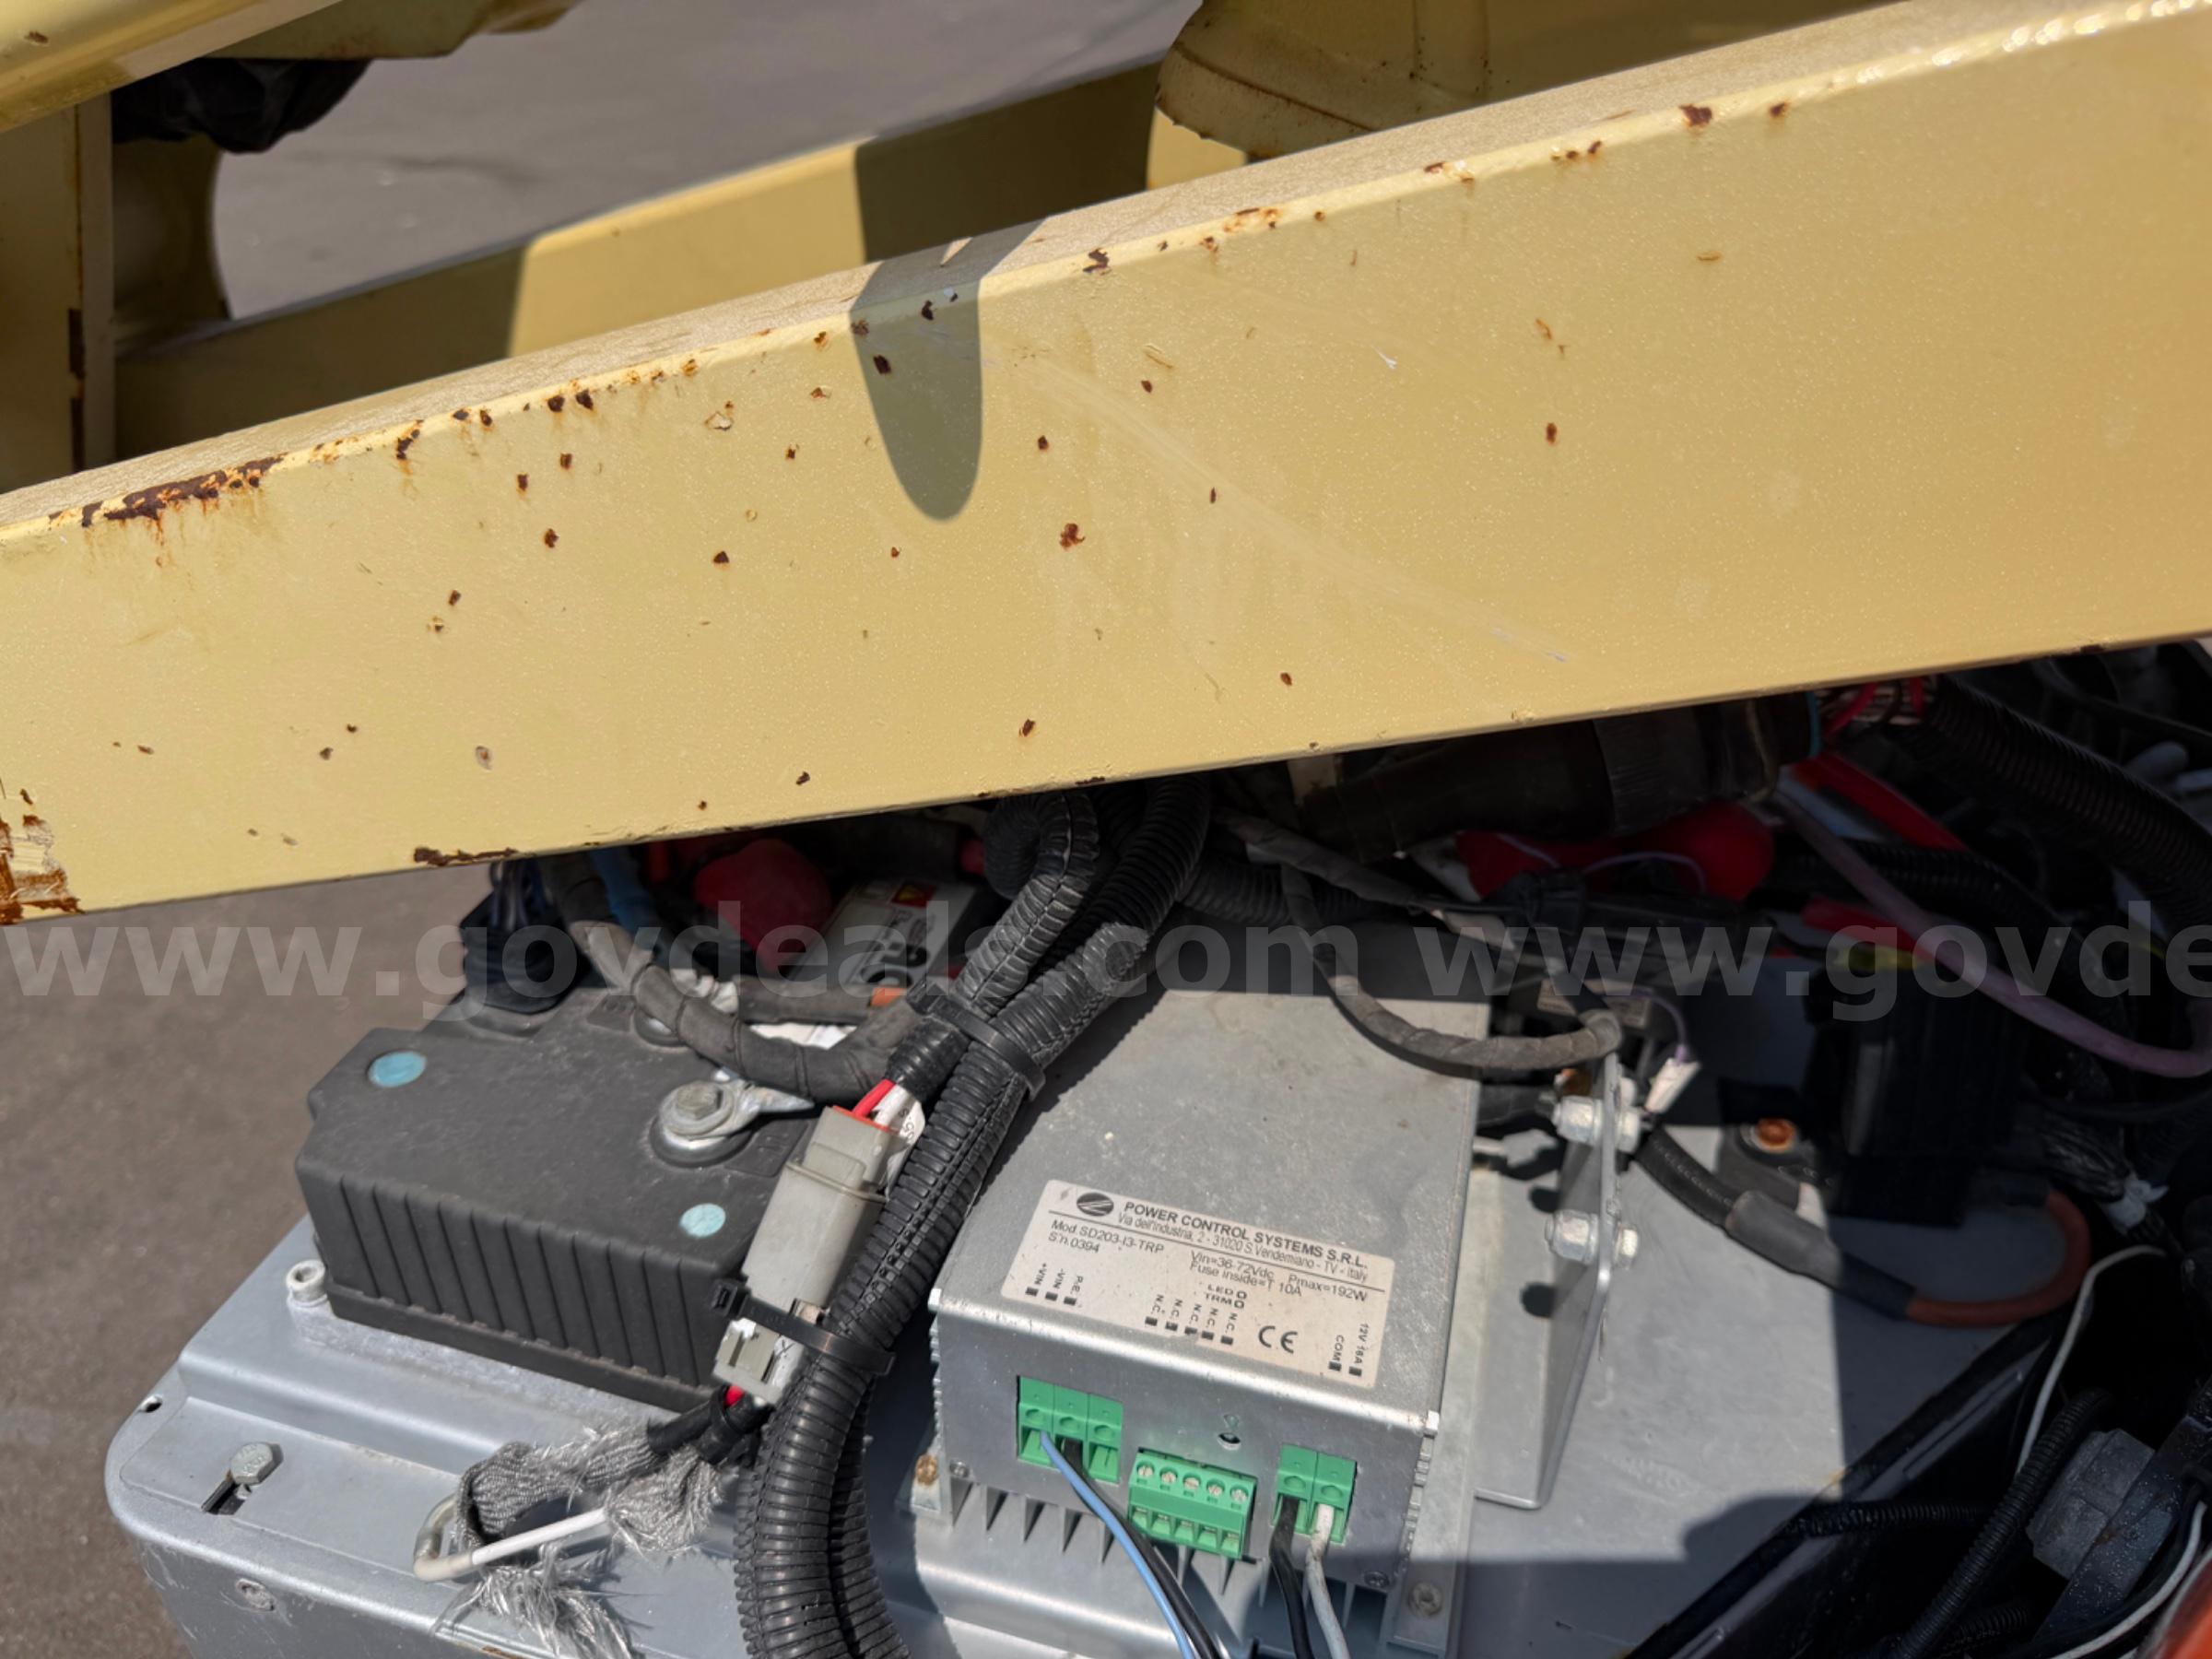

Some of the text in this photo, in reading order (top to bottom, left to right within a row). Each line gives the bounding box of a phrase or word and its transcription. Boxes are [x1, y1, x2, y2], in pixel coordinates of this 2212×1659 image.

[1118, 1212, 1133, 1226] Via
[1196, 1231, 1206, 1242] 2
[1212, 1236, 1243, 1253] 31020
[1324, 1260, 1336, 1275] TV
[1347, 1265, 1369, 1283] Italy
[1124, 1201, 1368, 1269] POWER CONTROL SYSTEMS S.R.L.
[1190, 1260, 1219, 1277] Fuse
[1278, 1281, 1302, 1297] 10A
[1206, 1283, 1234, 1296] LED
[1288, 1274, 1368, 1302] Pmax=192W
[1204, 1292, 1232, 1305] TRM
[1358, 1323, 1369, 1342] 12V
[1332, 1334, 1345, 1361] COM
